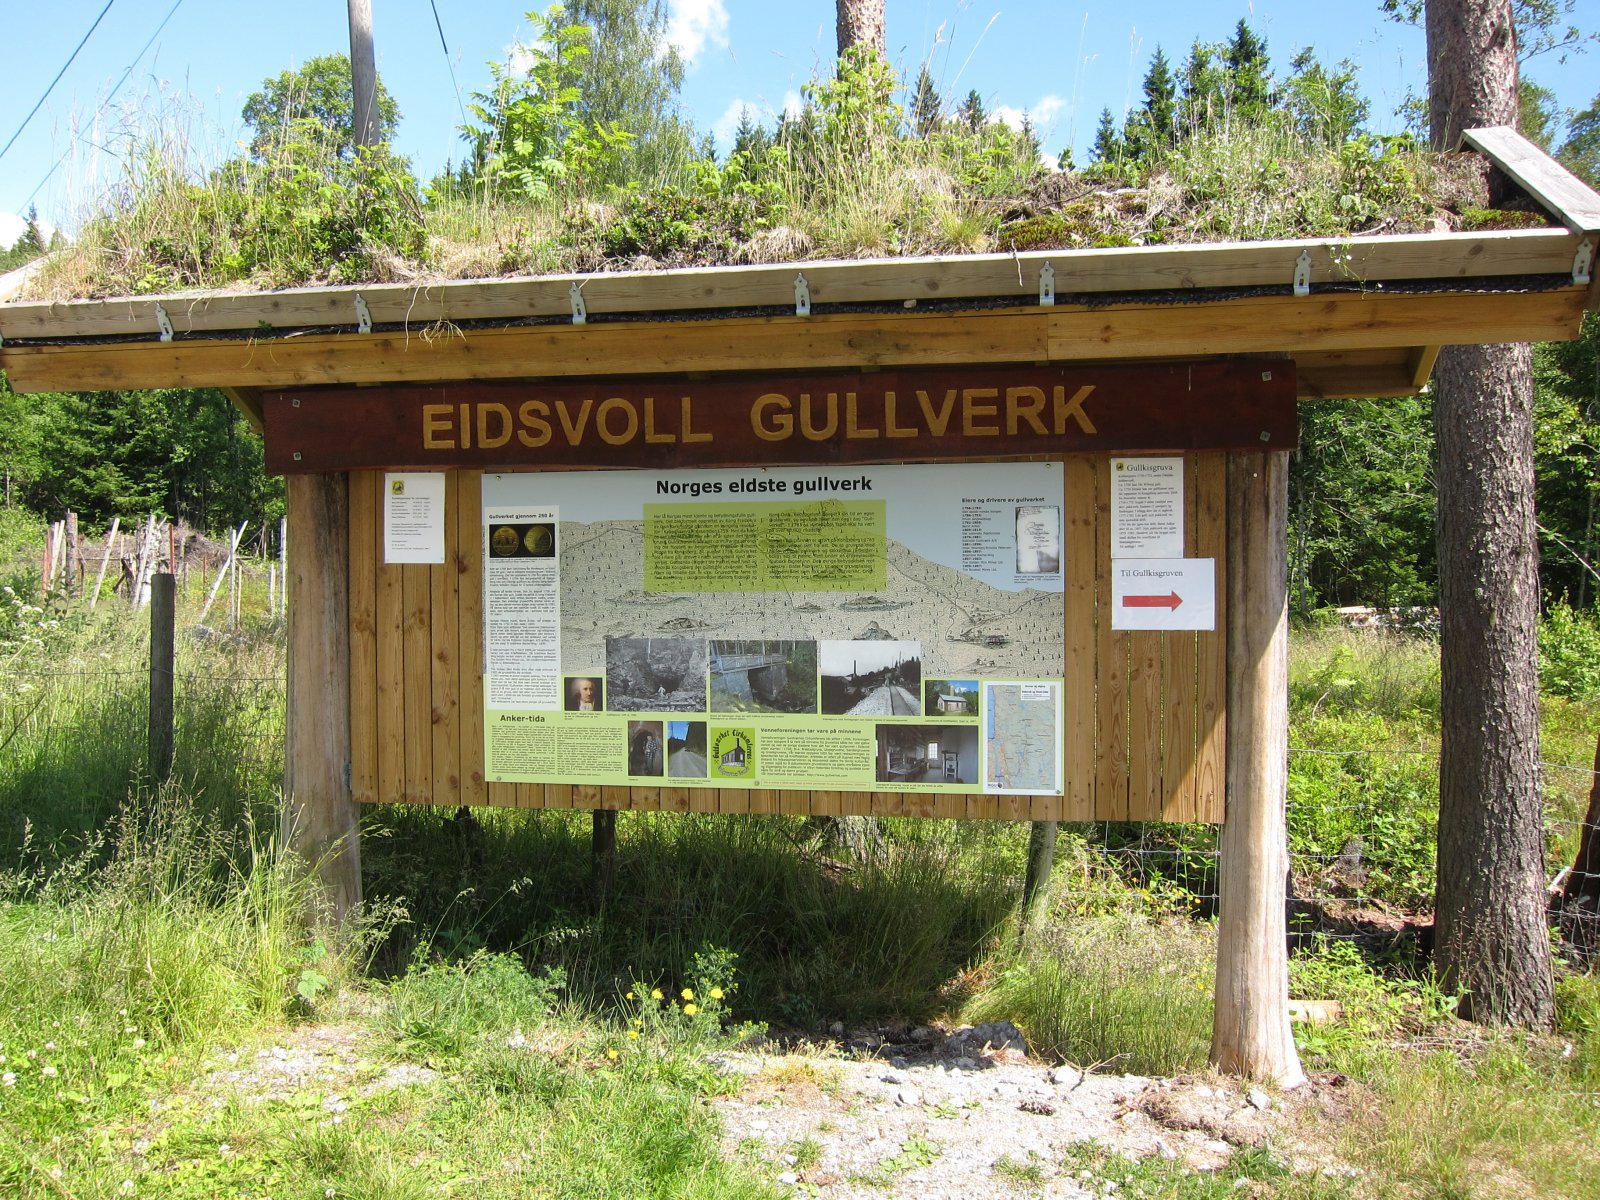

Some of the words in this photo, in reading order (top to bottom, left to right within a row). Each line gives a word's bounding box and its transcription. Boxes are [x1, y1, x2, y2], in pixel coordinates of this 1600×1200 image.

[423, 397, 714, 451] EIDSVOLL
[750, 385, 1098, 442] GULLVERK
[1126, 464, 1173, 472] Gullkisgruva
[656, 480, 723, 497] Norges
[728, 478, 787, 492] eldste
[792, 476, 873, 495] gullverk
[1120, 569, 1131, 577] Til
[1132, 569, 1183, 578] Gullkisgruven
[500, 714, 545, 722] Anker-tida
